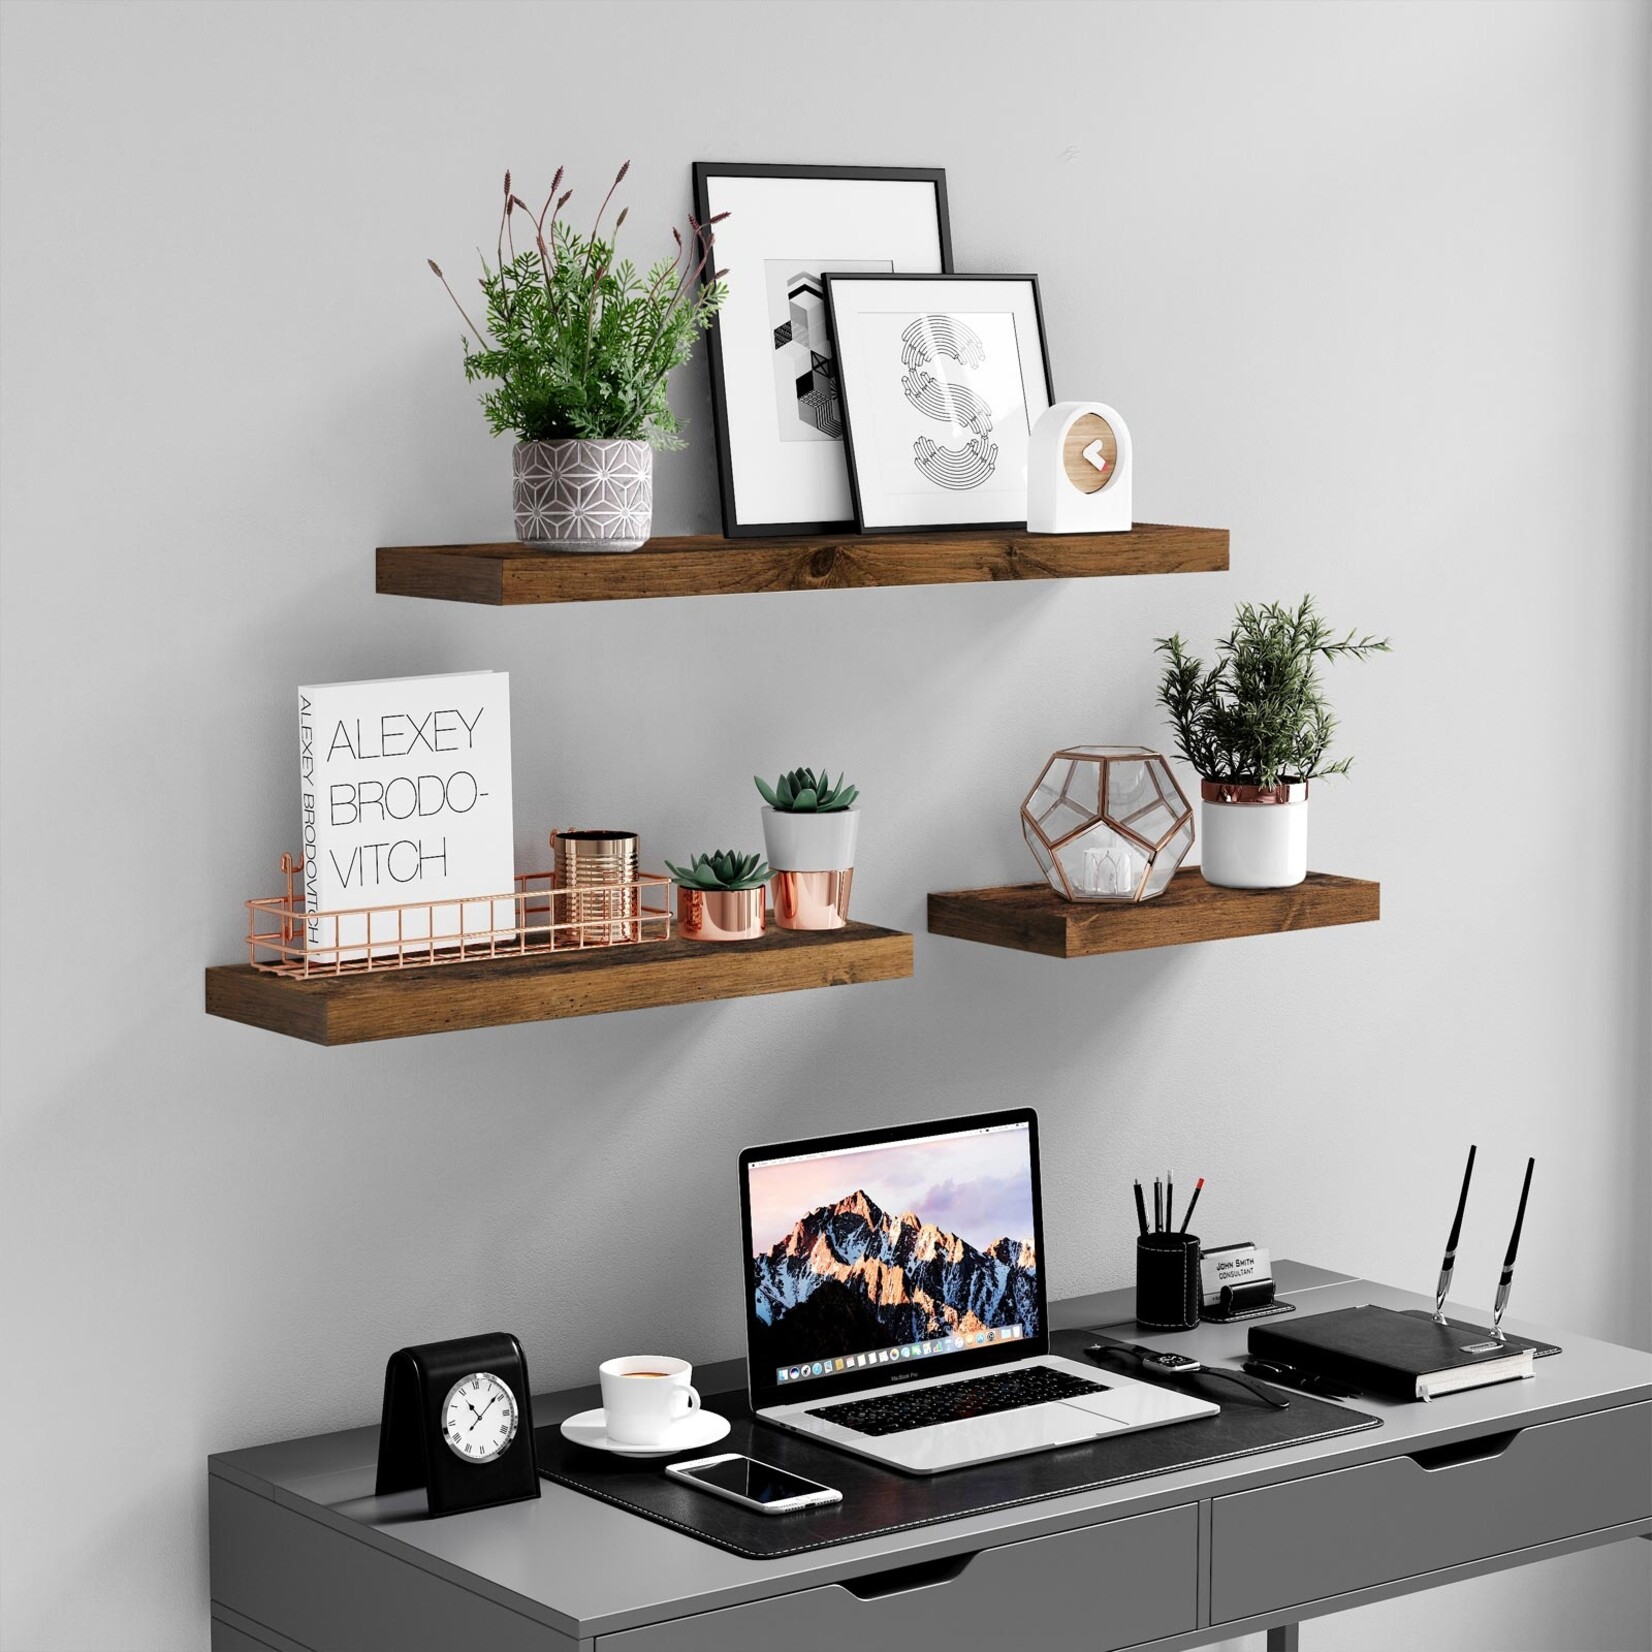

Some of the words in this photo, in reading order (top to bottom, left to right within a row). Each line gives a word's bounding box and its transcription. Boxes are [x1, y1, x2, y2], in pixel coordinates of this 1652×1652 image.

[300, 694, 314, 786] ALEXEY
[327, 707, 484, 762] ALEXEY
[330, 771, 489, 826] BRODO-
[303, 793, 319, 944] BRODOVITCH
[329, 836, 447, 888] VITCH
[1219, 1267, 1254, 1279] CONSULTANT
